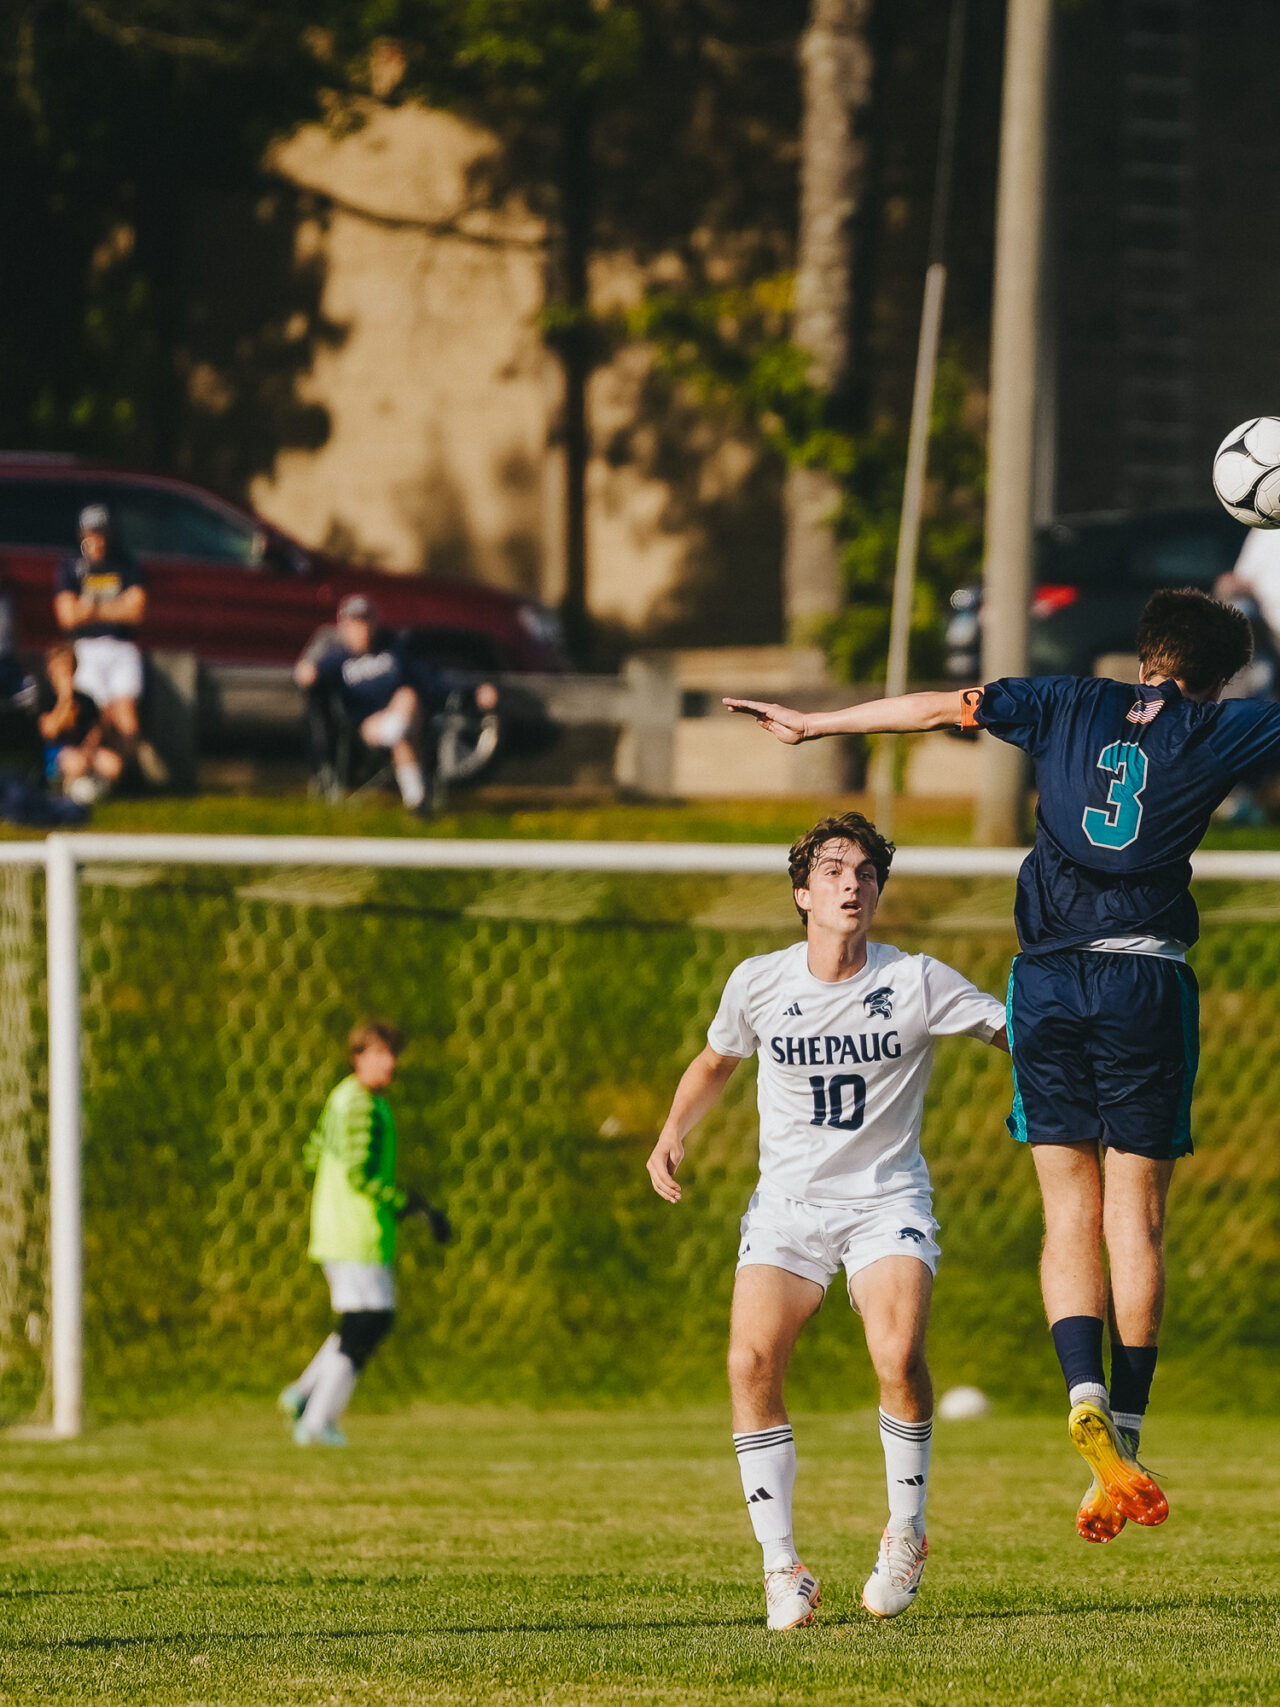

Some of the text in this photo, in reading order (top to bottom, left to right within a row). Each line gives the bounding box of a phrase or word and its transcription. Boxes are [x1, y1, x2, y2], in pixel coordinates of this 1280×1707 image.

[1082, 740, 1148, 850] 3
[771, 1031, 902, 1066] SHEPAUG
[809, 1074, 867, 1132] 10
